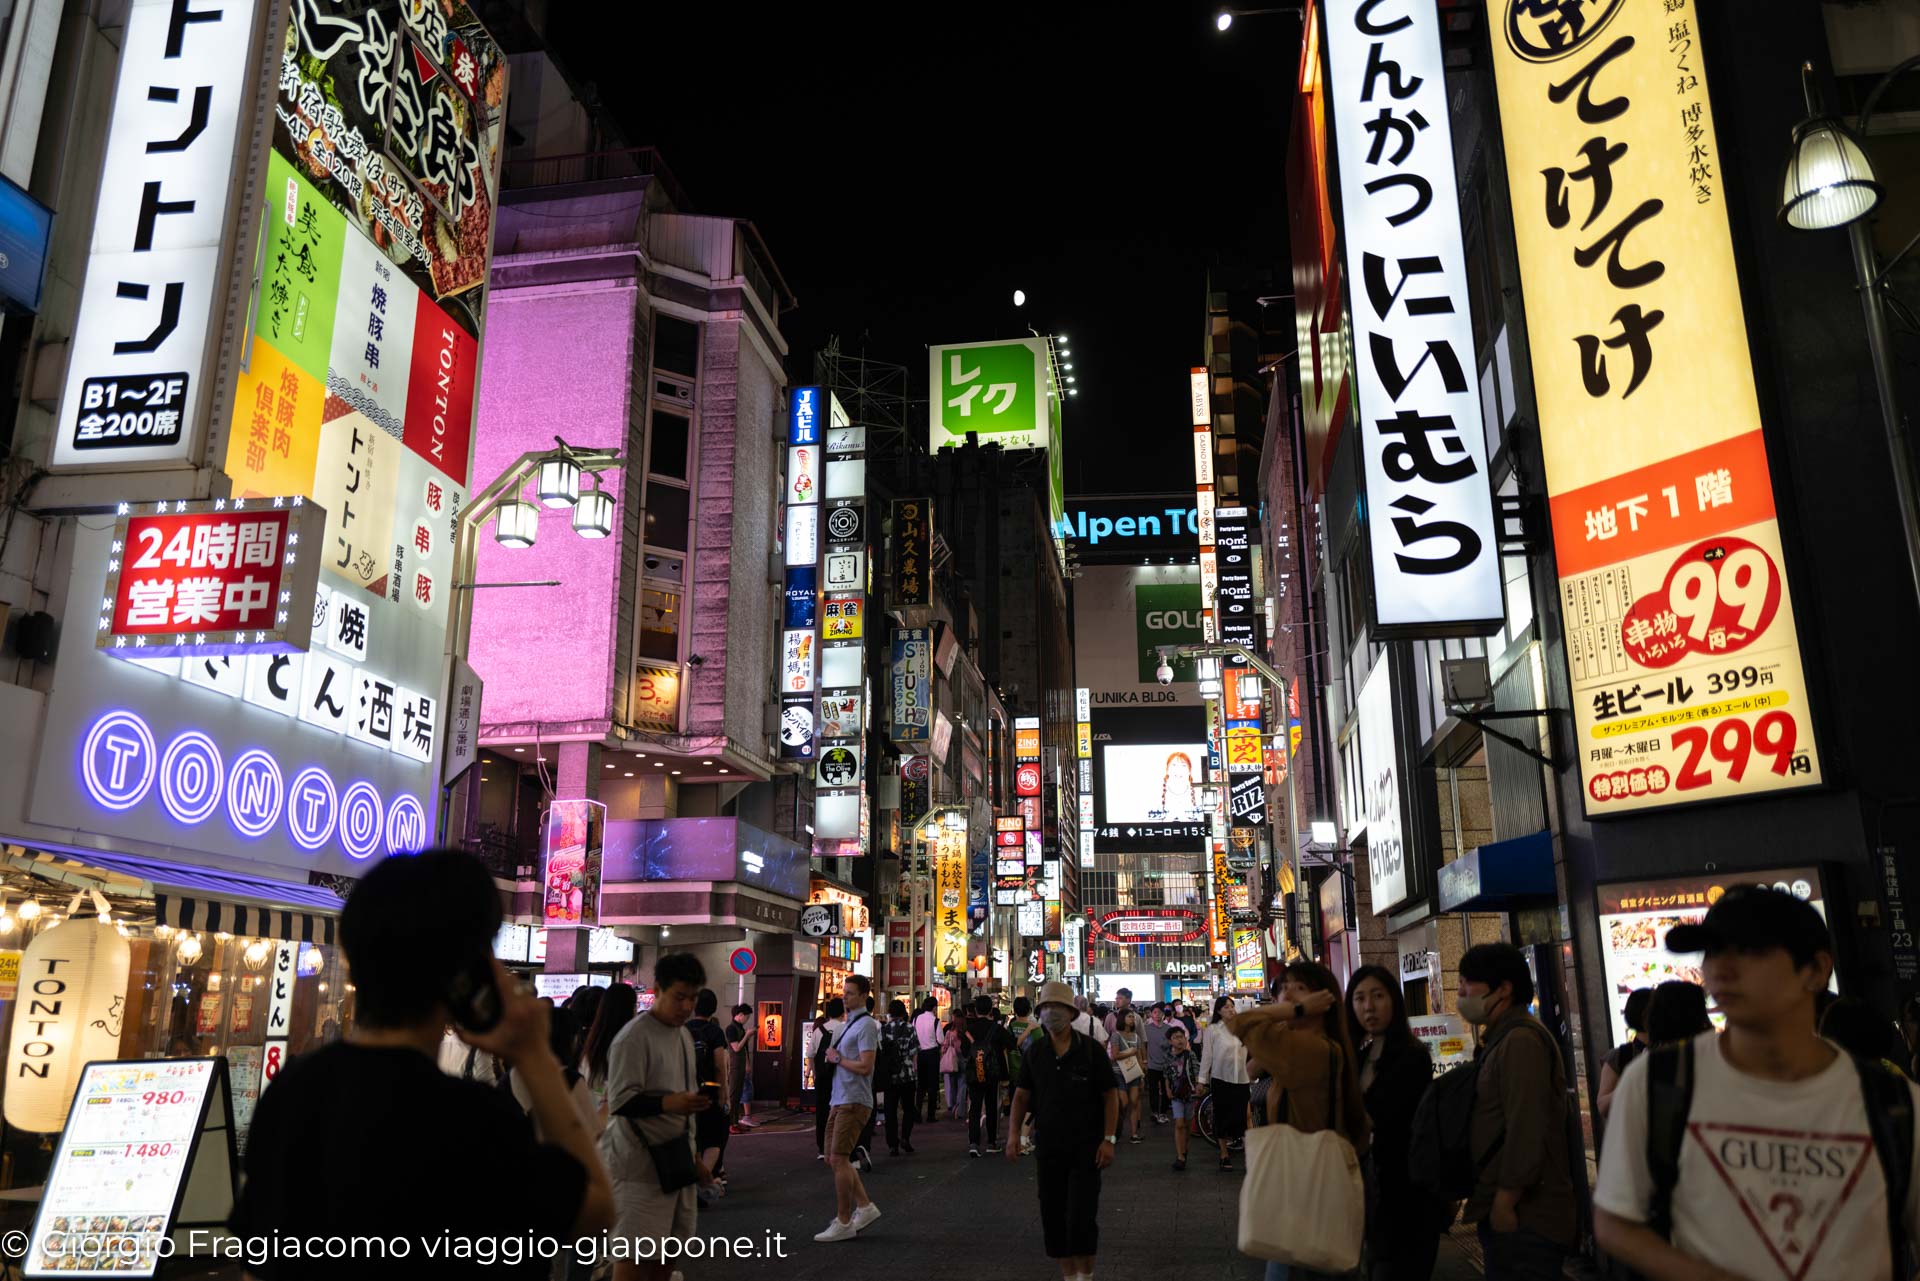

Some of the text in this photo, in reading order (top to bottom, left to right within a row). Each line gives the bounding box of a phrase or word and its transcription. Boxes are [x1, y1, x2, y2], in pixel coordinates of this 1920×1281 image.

[1668, 19, 1699, 95] 塩つくね
[280, 55, 424, 229] 新宿歌舞伎町店
[1680, 102, 1714, 204] 博多水炊き
[311, 140, 363, 201] 全120席
[370, 196, 434, 269] 完全個室あり
[1539, 36, 1666, 401] てけてけ
[1352, 0, 1483, 575] とんかつ にいむら
[363, 282, 388, 371] 焼豚串
[431, 329, 455, 461] TONTON
[948, 354, 1017, 417] レイク
[76, 408, 180, 442] 全200席
[245, 381, 275, 474] 倶楽部
[271, 367, 300, 460] 焼豚肉
[796, 390, 814, 442] JAビル
[336, 427, 364, 570] トントン
[1583, 467, 1734, 543] 地下1階
[131, 520, 281, 571] 24時間
[1062, 511, 1161, 544] Alpen
[125, 574, 269, 627] 営業中
[805, 618, 814, 626] 2F
[825, 602, 858, 618] 麻雀
[337, 602, 367, 652] 焼
[898, 629, 923, 641] 麻雀
[1624, 610, 1678, 650] 串物
[1637, 633, 1687, 664] いろいろ
[1142, 692, 1179, 704] BLDG.
[1592, 676, 1694, 722] 生ビール
[900, 727, 920, 740] 4F
[1017, 738, 1039, 748] ZINO
[103, 732, 420, 851] TONTON
[835, 765, 851, 773] Olive
[1592, 766, 1667, 798] 特別価格
[907, 781, 917, 822] カリーナ
[998, 818, 1022, 829] ZINO
[1121, 920, 1181, 932] 歌舞伎町一番街
[1891, 932, 1913, 948] 23
[1165, 961, 1206, 974] Alpen
[1214, 955, 1228, 963] 2F
[18, 958, 71, 1079] TONTON
[1720, 1136, 1846, 1179] GUESS
